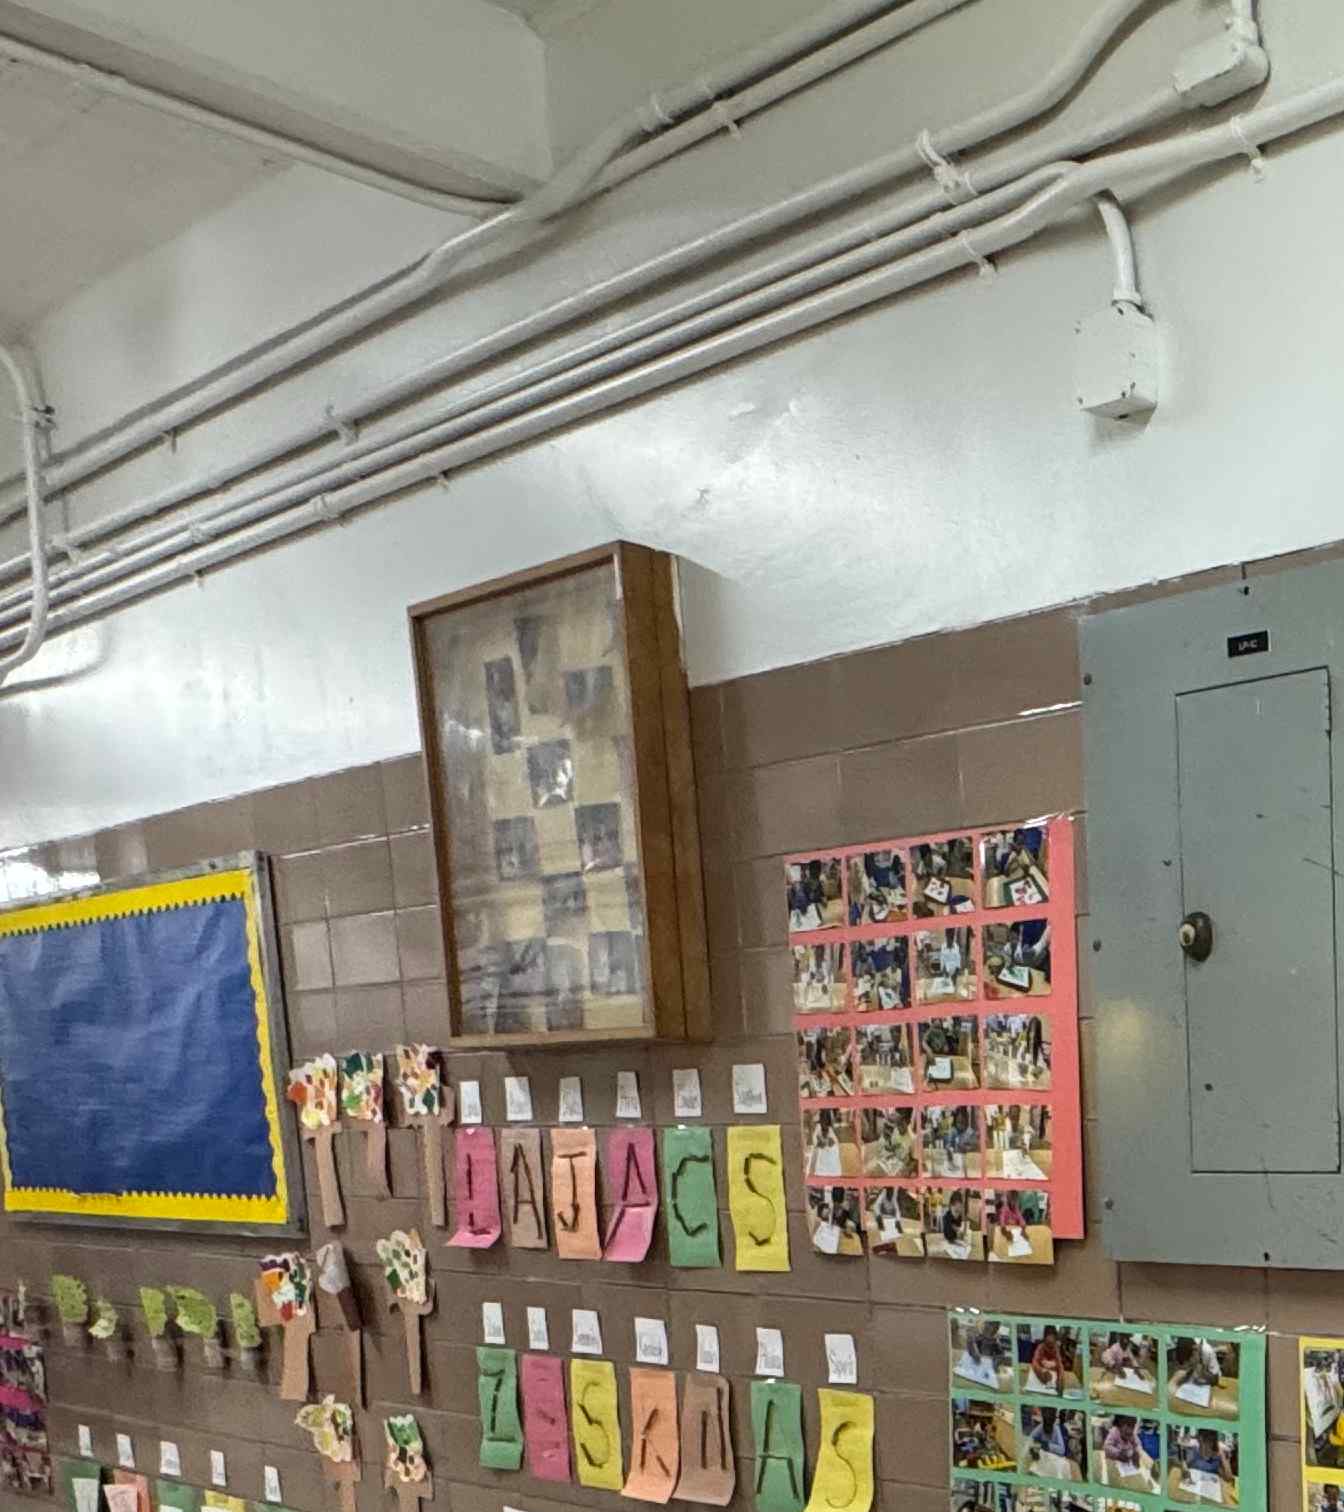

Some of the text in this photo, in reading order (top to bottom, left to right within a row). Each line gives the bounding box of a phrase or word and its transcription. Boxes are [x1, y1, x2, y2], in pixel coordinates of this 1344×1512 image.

[510, 1143, 544, 1240] A
[557, 1151, 588, 1232] J
[671, 1154, 711, 1237] C
[744, 1152, 778, 1246] S
[577, 1381, 611, 1469] S
[756, 1399, 800, 1500] A
[824, 1419, 860, 1510] S
